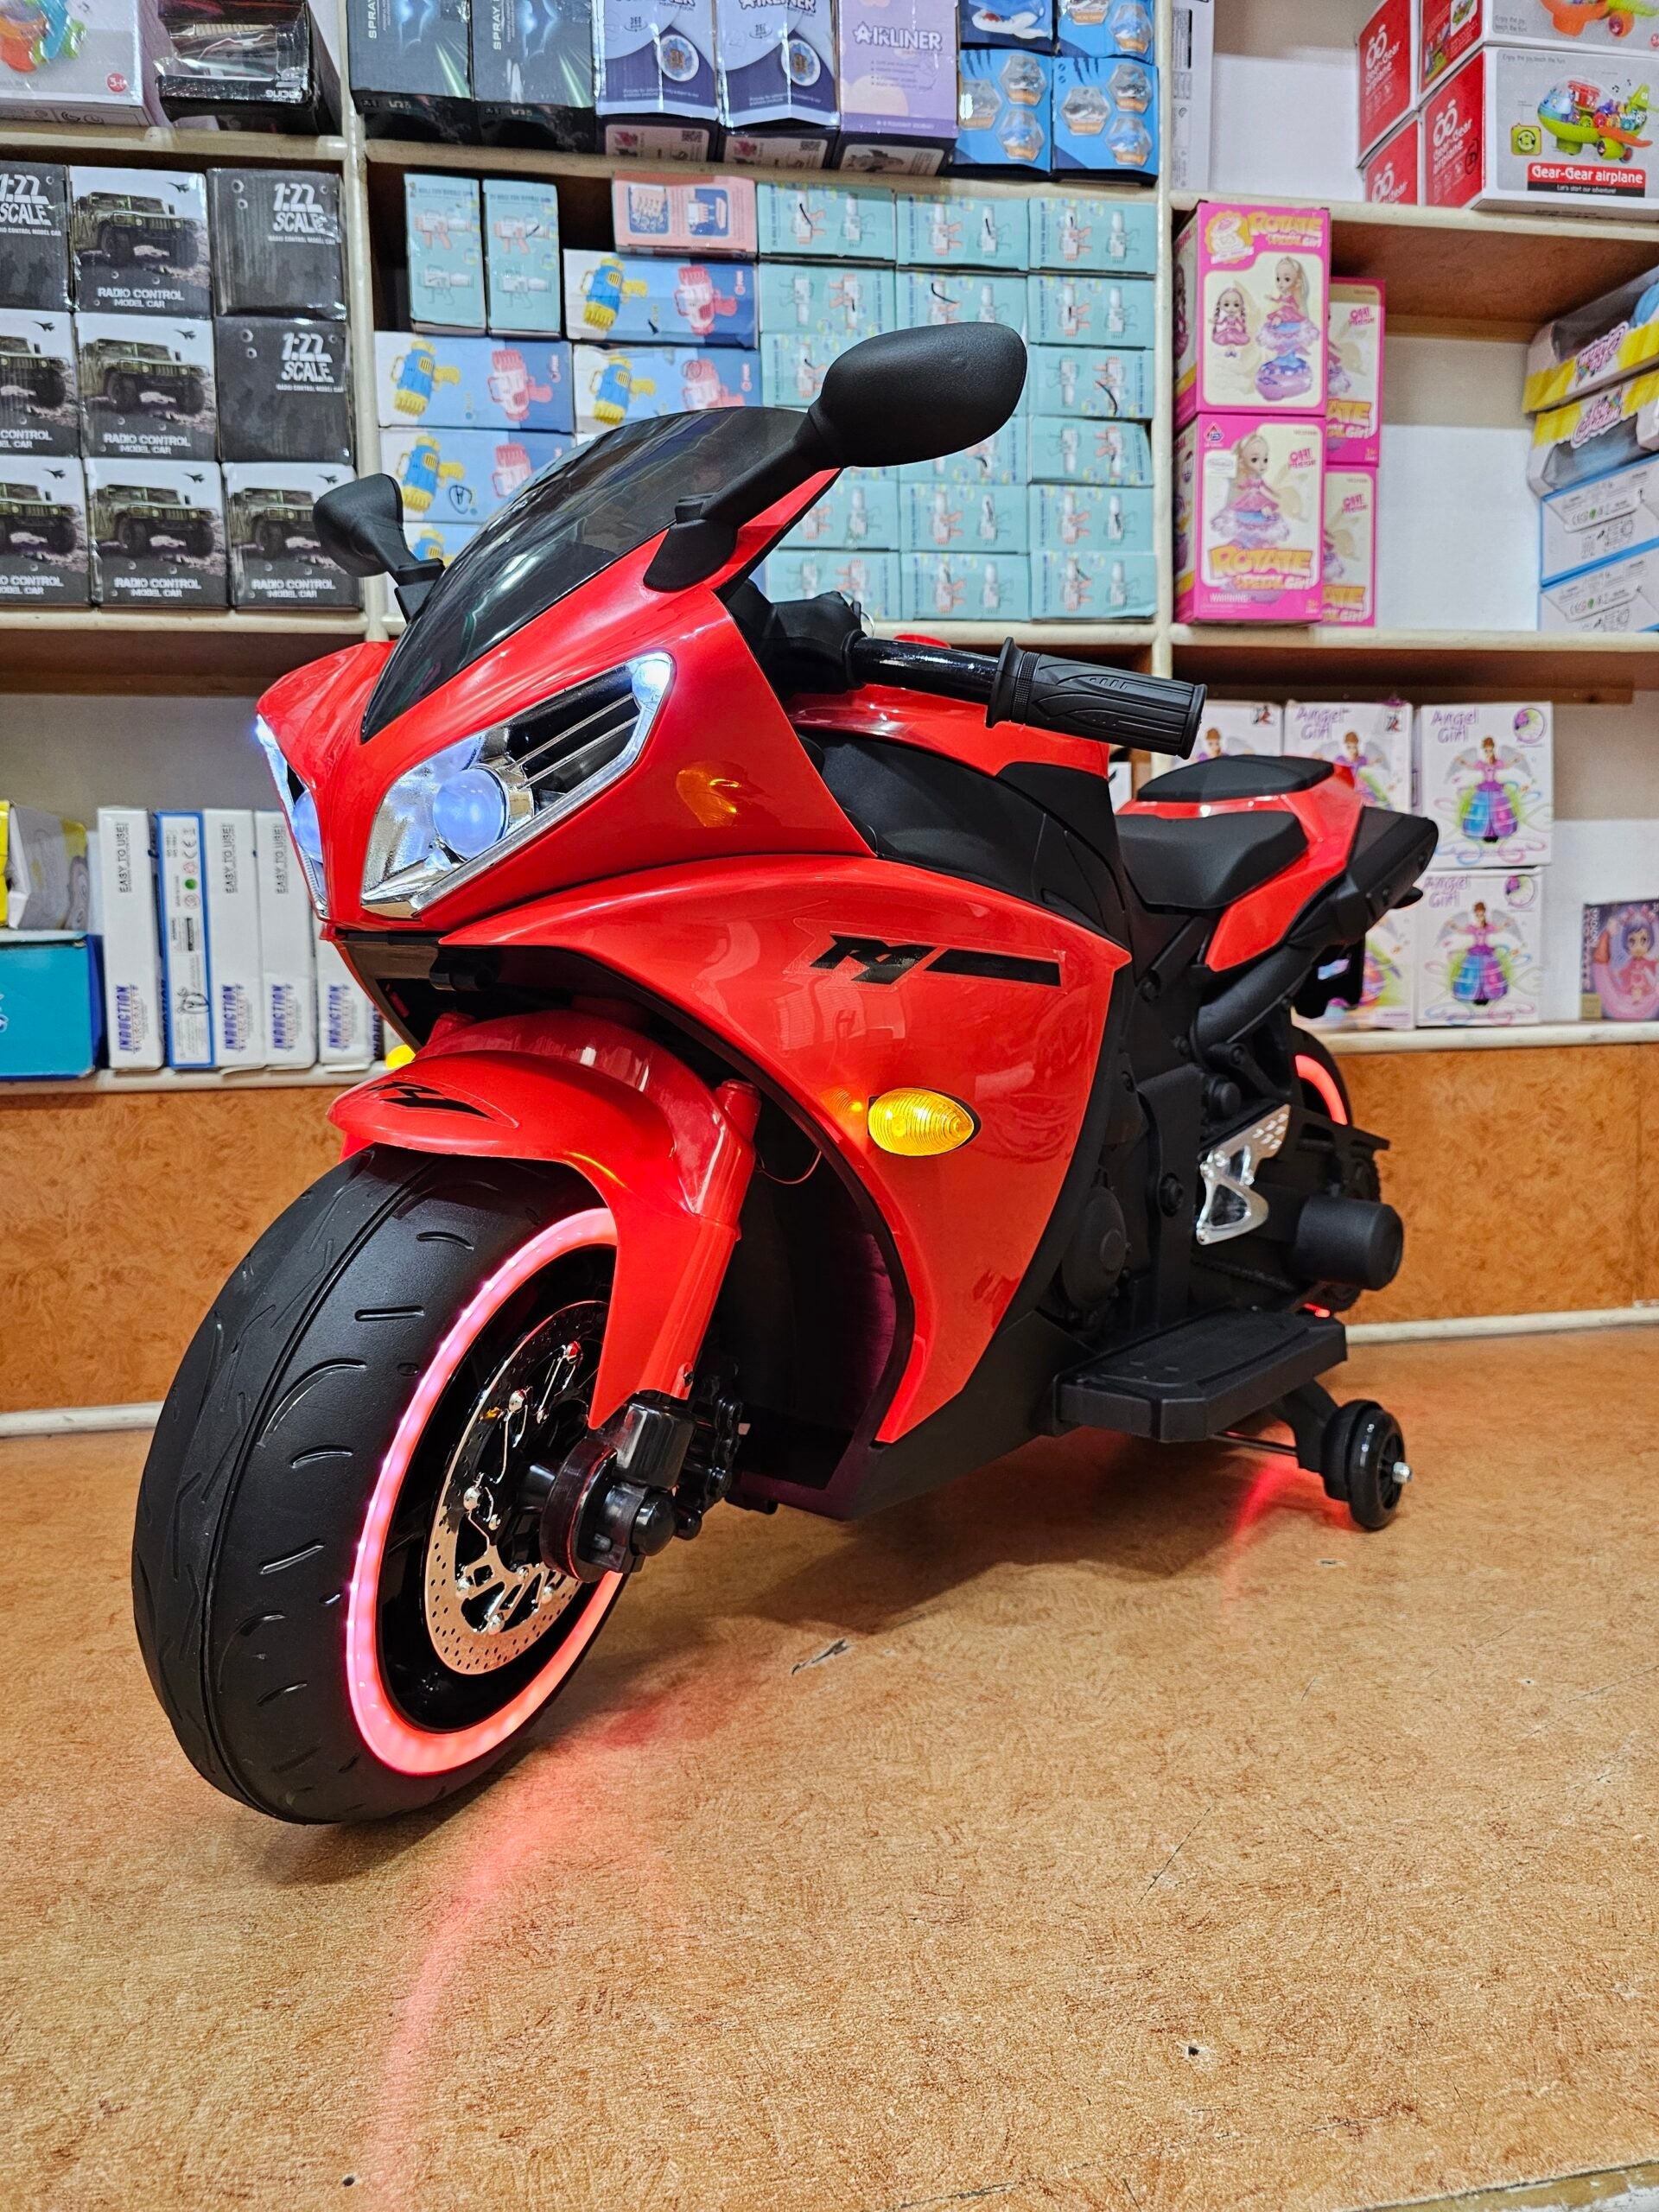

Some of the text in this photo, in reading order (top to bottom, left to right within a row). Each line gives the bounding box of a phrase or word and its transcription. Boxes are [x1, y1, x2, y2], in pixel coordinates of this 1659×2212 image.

[369, 0, 378, 39] SPRA
[493, 6, 503, 50] SPRAY
[853, 21, 943, 51] AIRLINER
[1532, 165, 1643, 186] Gear-Gear airplane
[273, 182, 324, 213] 1:22
[0, 203, 53, 226] SCALE
[273, 213, 327, 234] SCALE
[97, 287, 185, 302] RADIO CONTROL
[113, 299, 166, 308] MODEL CAR
[282, 332, 334, 363] 1:22
[281, 360, 335, 383] SCALE
[0, 429, 53, 442] CONTROL
[14, 440, 33, 448] CAR
[103, 432, 191, 448] RADIO CONTROL
[120, 444, 172, 455] MODEL CAR
[1208, 544, 1313, 579] ROTATE
[10, 575, 64, 588] CONTROL
[26, 587, 45, 595] CAR
[114, 576, 201, 590] RADIO CONTROL
[251, 578, 336, 591] RADIO CONTROL
[130, 588, 182, 598] MODEL CAR
[267, 588, 318, 599] MODEL CAR
[1296, 705, 1345, 723] Angel
[1430, 708, 1479, 726] Angel
[1300, 721, 1332, 741] Girl
[1438, 725, 1468, 744] Girl
[117, 849, 126, 862] TO
[222, 850, 232, 863] TO
[274, 850, 284, 863] TO
[118, 868, 129, 893] EASY
[223, 868, 235, 893] EASY
[275, 868, 286, 894] EASY
[1424, 874, 1470, 892] Angel
[116, 985, 132, 1052] INDUCTION
[222, 984, 238, 1051] INDUCTION
[271, 984, 286, 1050] INDUCTION
[327, 984, 342, 1051] INDUCTION
